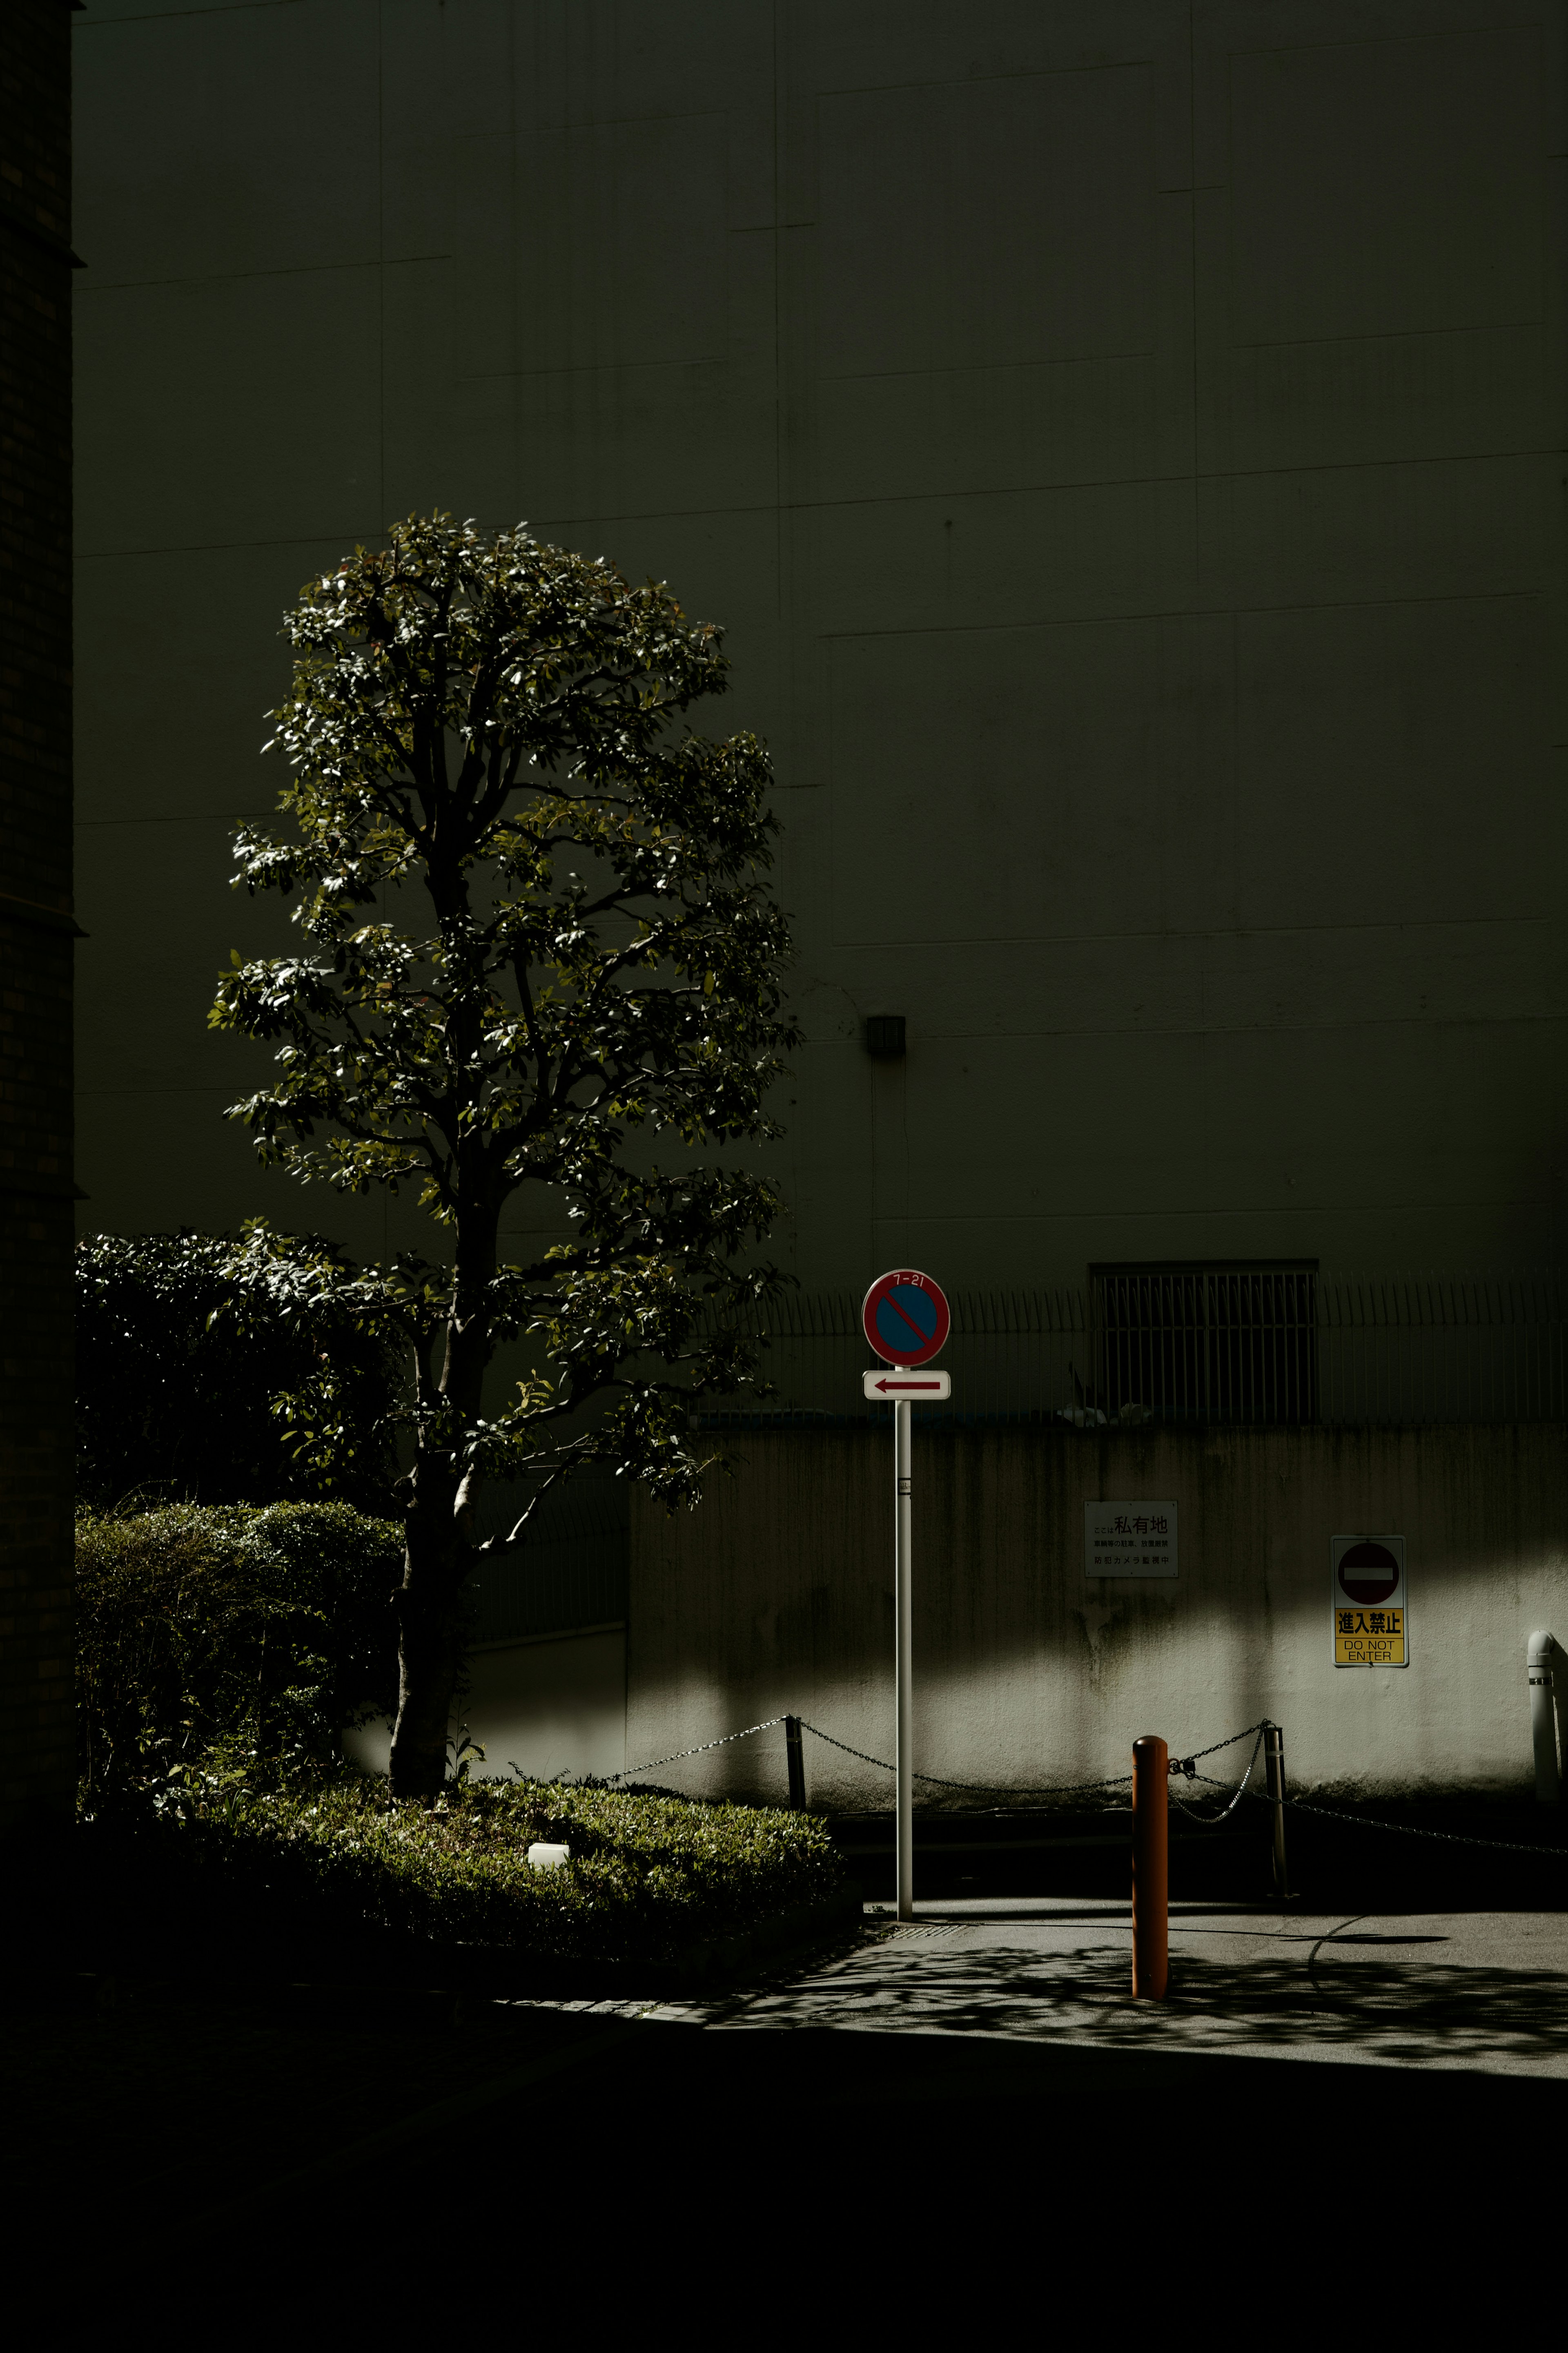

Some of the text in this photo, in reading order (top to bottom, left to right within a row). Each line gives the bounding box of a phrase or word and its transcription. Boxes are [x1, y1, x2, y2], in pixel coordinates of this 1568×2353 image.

[893, 1274, 924, 1287] 7-21
[1339, 1613, 1401, 1634] 進入禁止
[1345, 1641, 1395, 1650] DO NOT
[1349, 1652, 1391, 1660] ENTER
